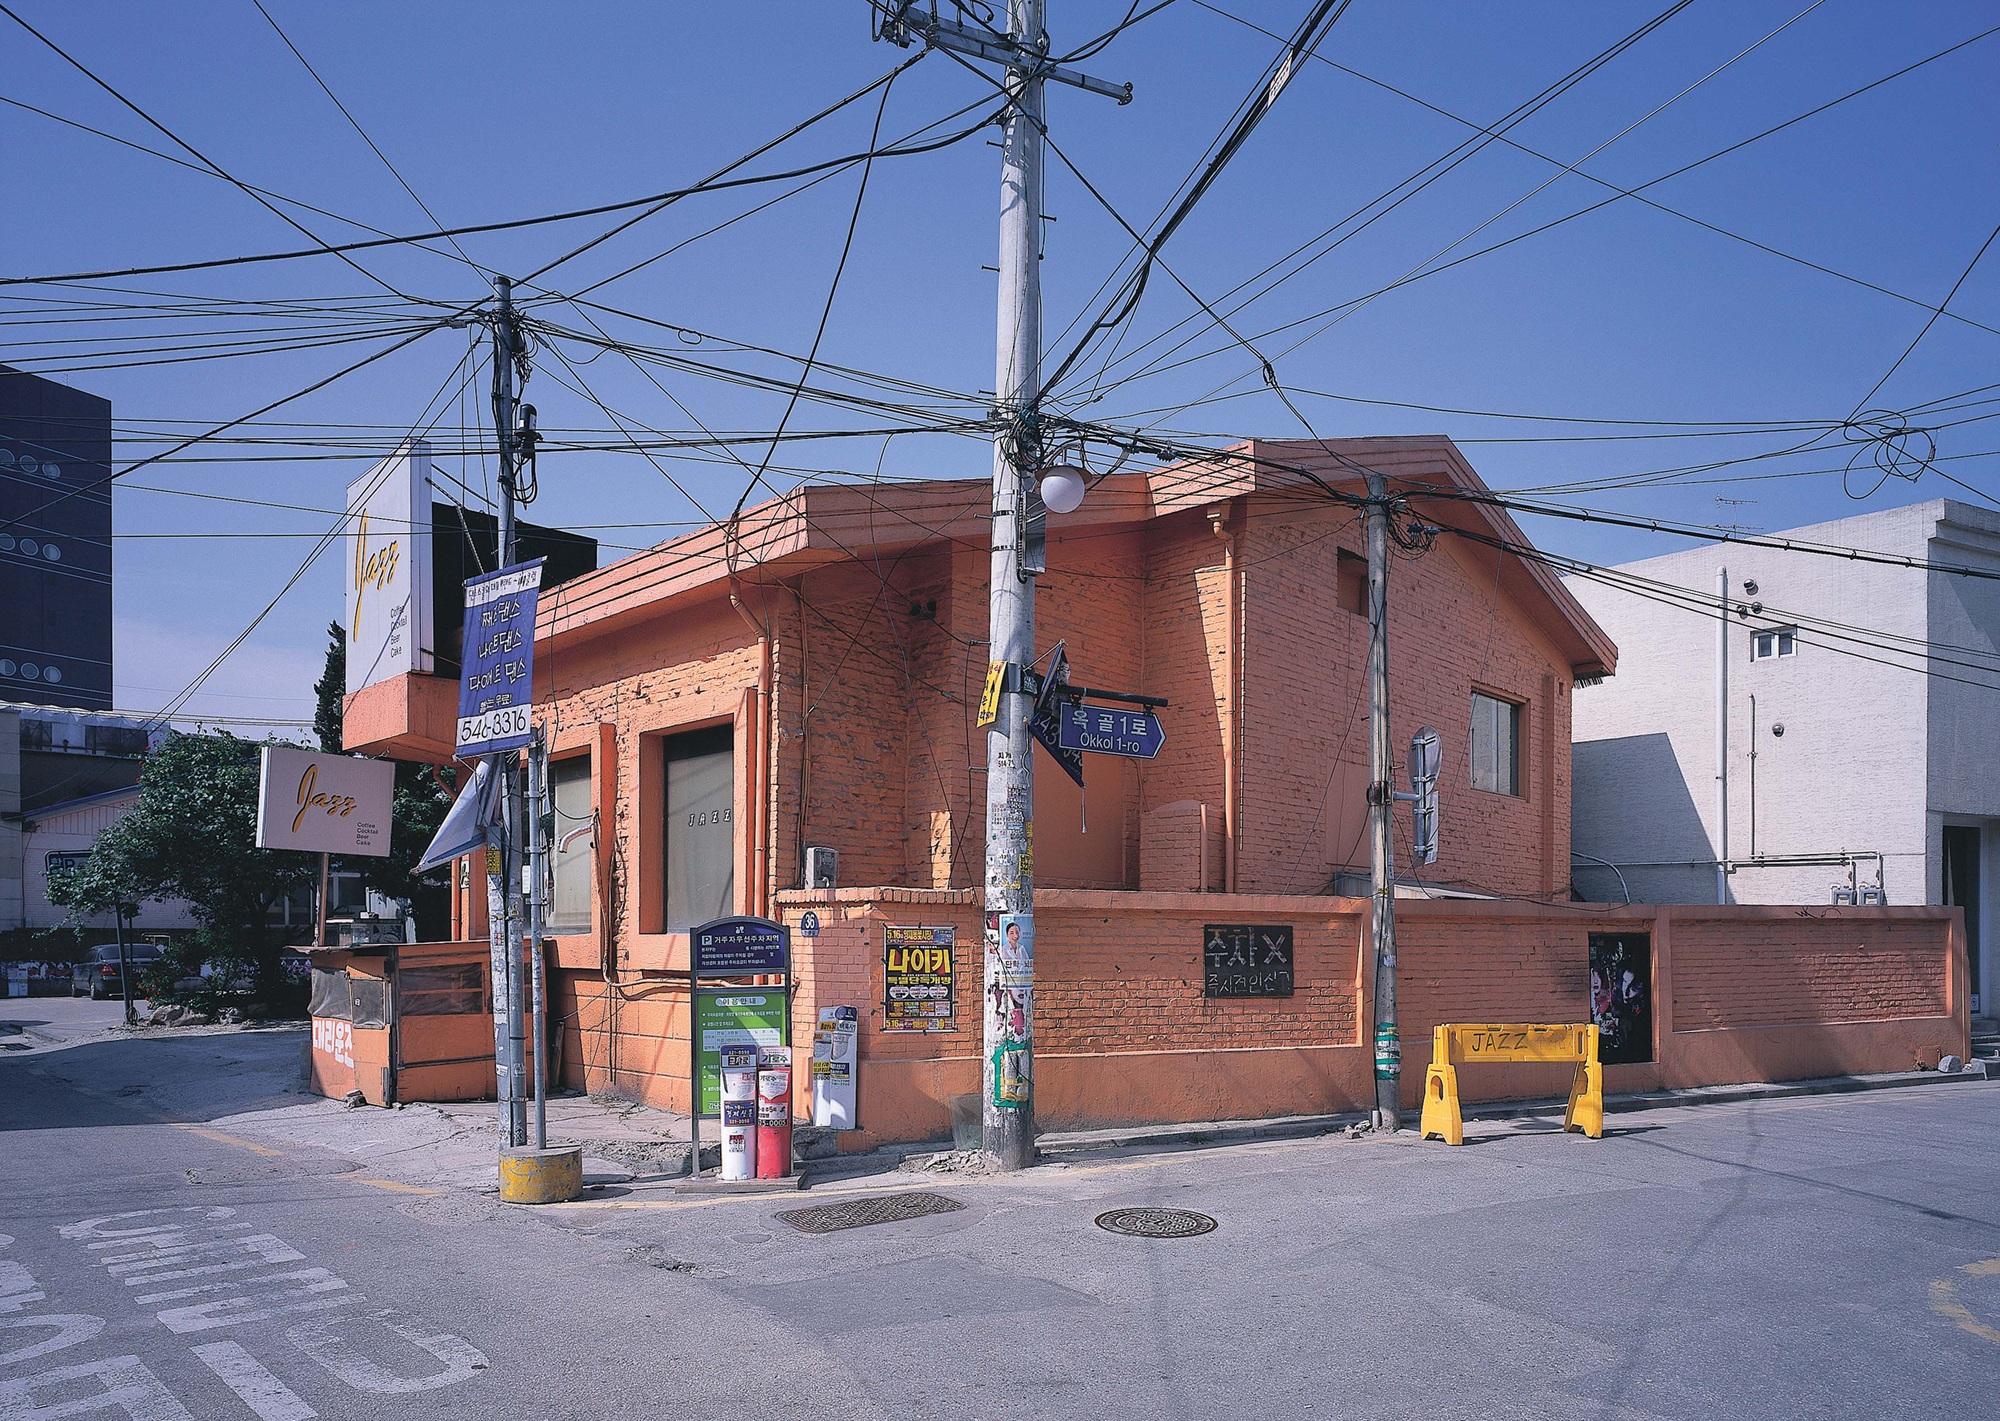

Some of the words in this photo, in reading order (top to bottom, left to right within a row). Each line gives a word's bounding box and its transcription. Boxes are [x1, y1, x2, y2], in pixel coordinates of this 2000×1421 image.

[353, 508, 400, 644] Jazz
[390, 633, 401, 645] Beer
[390, 646, 402, 658] Cake
[504, 658, 526, 684] 댄스
[1080, 732, 1114, 750] Okkol
[1117, 737, 1140, 753] 1-ro
[292, 763, 357, 833] Jazz
[357, 821, 375, 829] Coffee
[688, 808, 731, 827] JAZZ
[804, 913, 815, 929] 36
[886, 929, 900, 939] 5.16
[1205, 926, 1258, 968] 주차
[888, 948, 951, 974] 나이키
[887, 976, 952, 985] 특별단독개방
[1471, 1031, 1528, 1053] JAZZ
